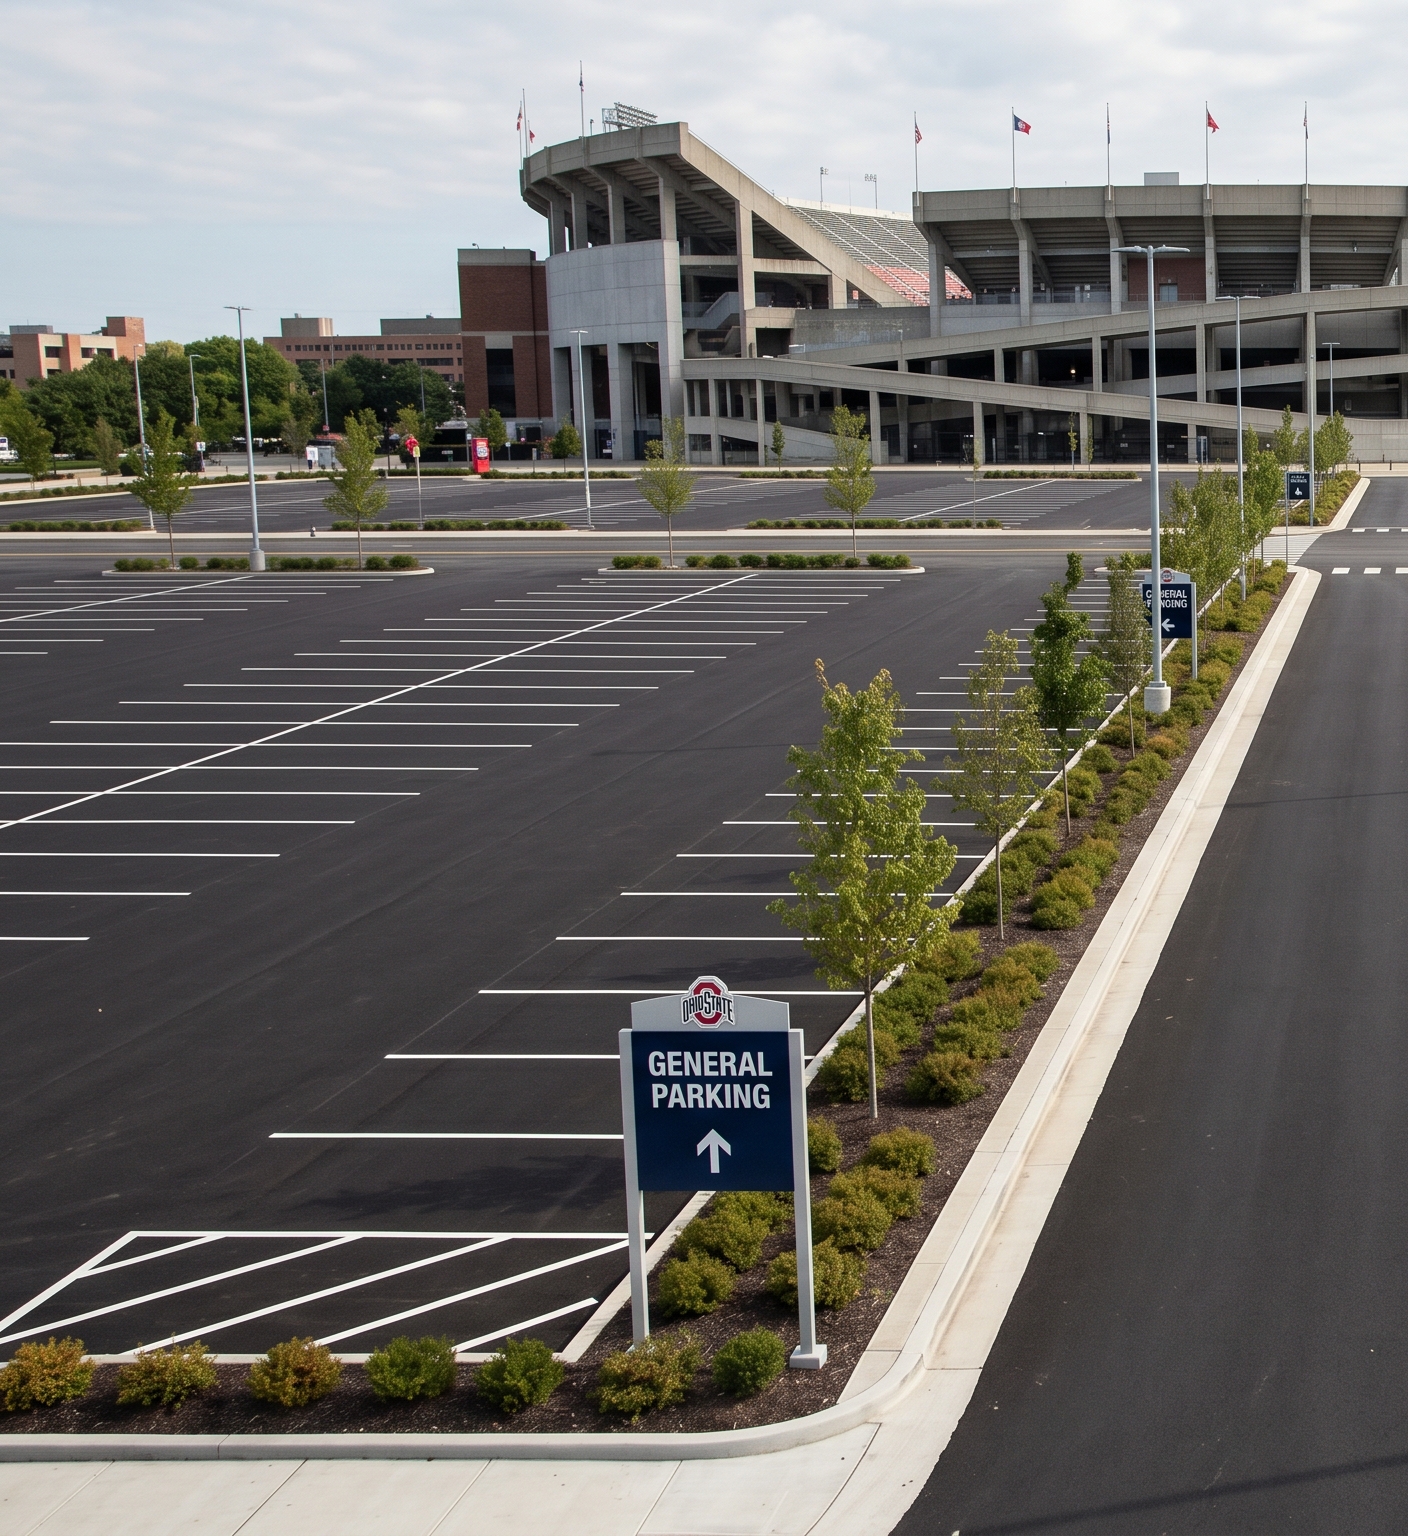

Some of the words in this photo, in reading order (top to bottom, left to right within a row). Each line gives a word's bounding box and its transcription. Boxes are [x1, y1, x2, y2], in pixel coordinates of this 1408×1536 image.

[1145, 590, 1187, 598] GERAL
[649, 1051, 773, 1077] GENERAL
[652, 1084, 770, 1109] PARKING
